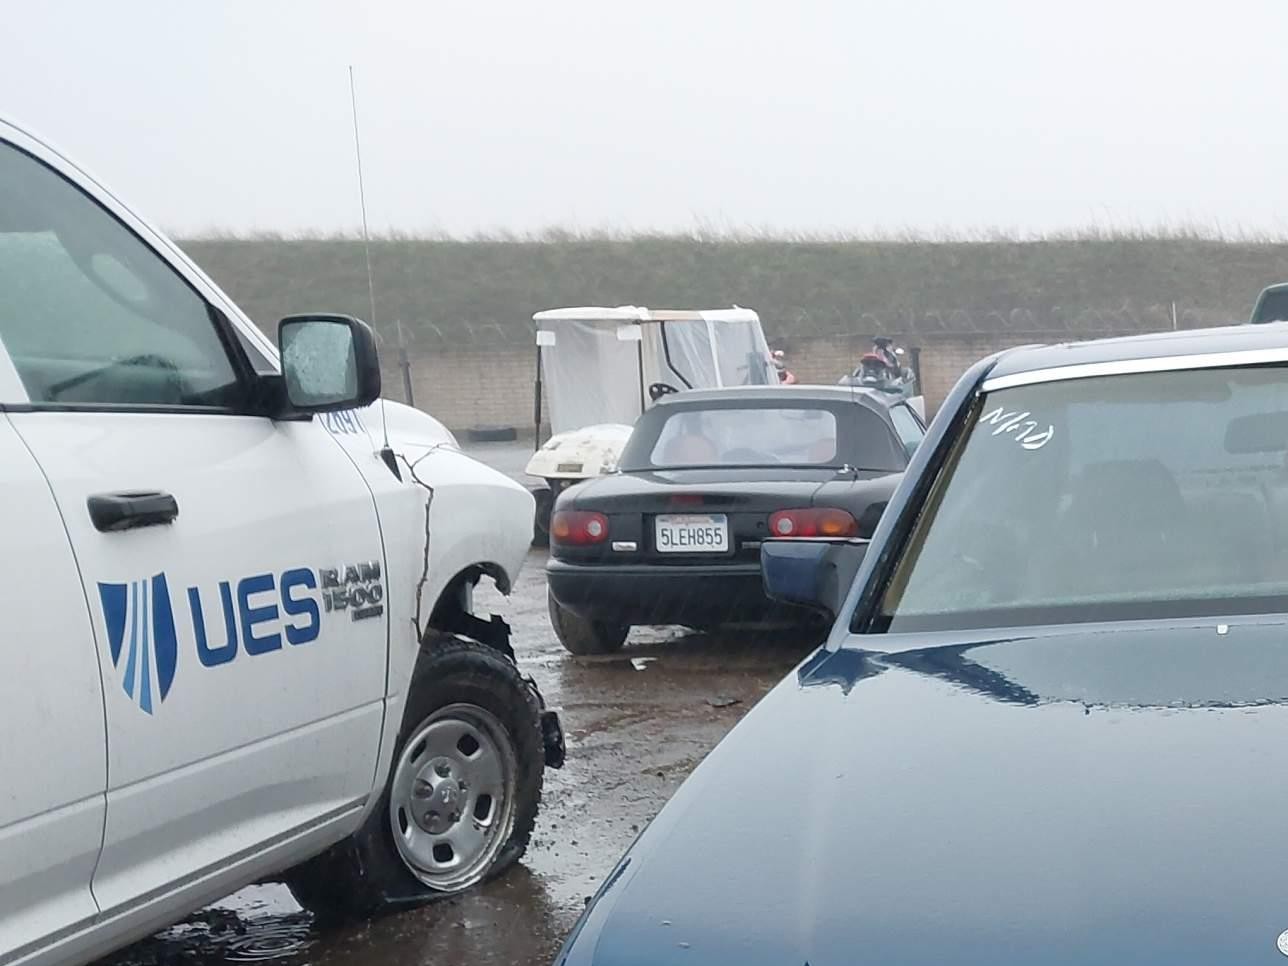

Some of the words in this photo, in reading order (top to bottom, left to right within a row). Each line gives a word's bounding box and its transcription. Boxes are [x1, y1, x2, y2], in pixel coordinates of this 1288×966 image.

[661, 527, 723, 546] 5LEH855
[319, 560, 381, 589] RAM
[322, 584, 383, 613] 1500
[187, 568, 321, 668] UES
